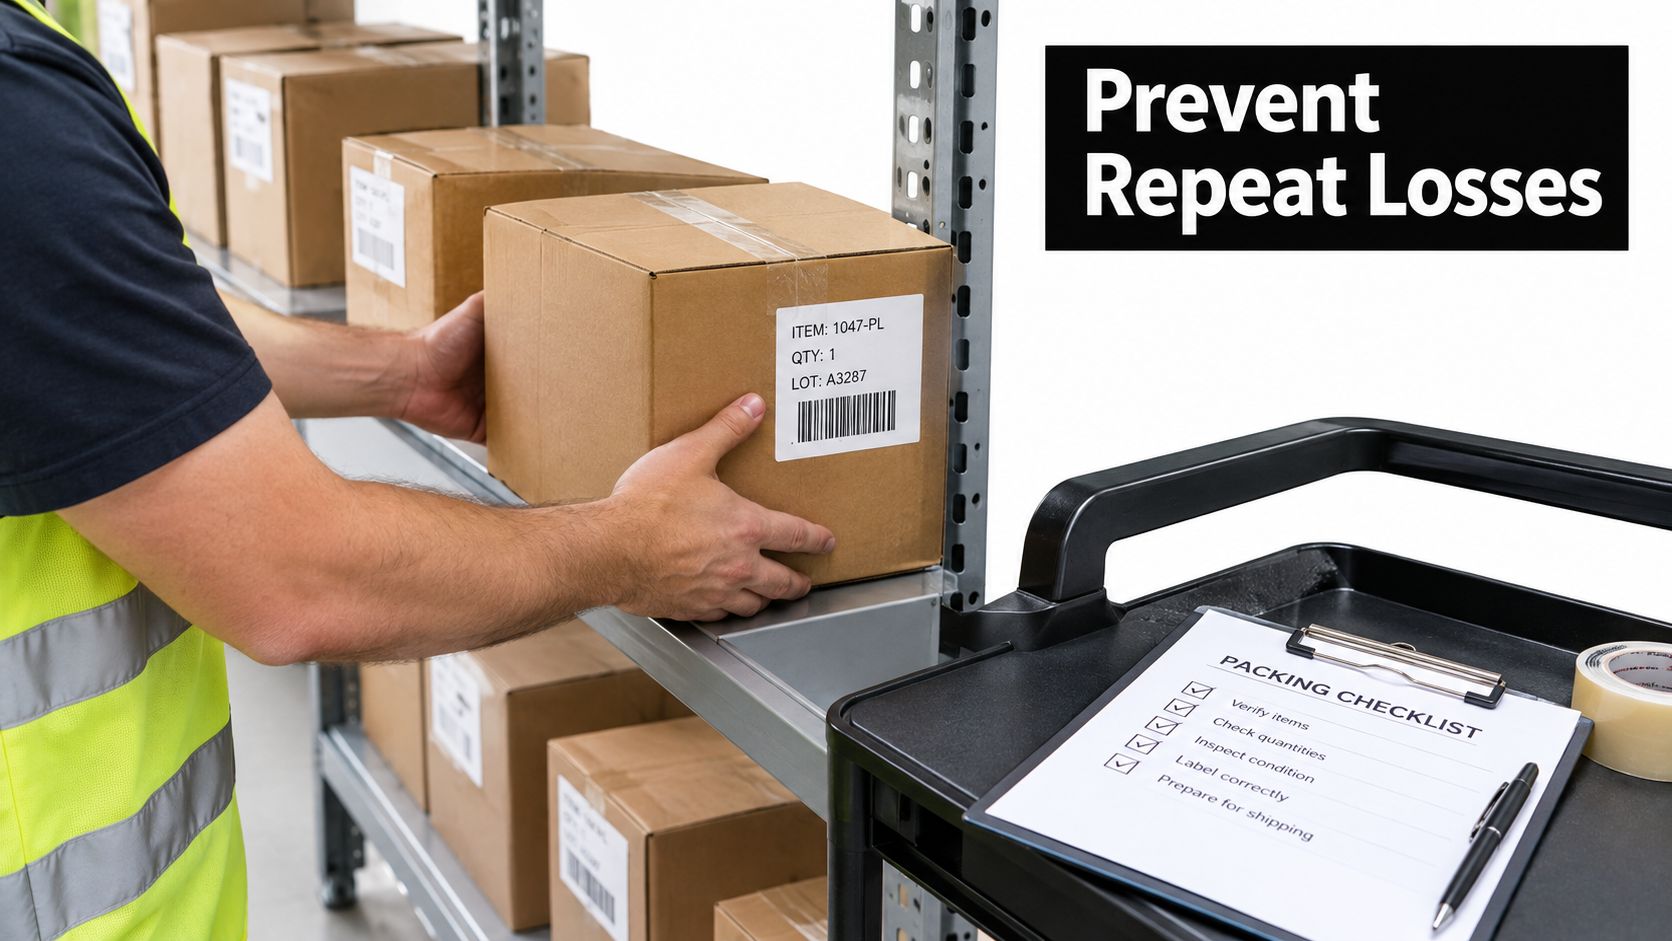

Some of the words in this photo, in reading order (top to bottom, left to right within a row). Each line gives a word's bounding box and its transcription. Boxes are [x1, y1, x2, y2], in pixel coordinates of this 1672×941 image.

[792, 323, 828, 339] ITEM:
[833, 317, 885, 335] 1047-PL
[791, 349, 824, 365] QTY:
[829, 348, 835, 361] 1
[791, 375, 822, 391] LOT:
[826, 369, 867, 387] A3287
[1219, 654, 1332, 697] PACKING
[1336, 690, 1484, 740] CHECKLIST
[1231, 698, 1270, 718] Verify
[1271, 711, 1311, 731] items
[1194, 735, 1247, 761] Inspect
[1248, 754, 1316, 784] condition
[1212, 716, 1256, 738] Check
[1258, 730, 1328, 762] quantities
[1174, 753, 1217, 778] Label
[1219, 770, 1291, 804] correctly
[1156, 773, 1218, 804] Prepare
[1221, 797, 1246, 816] for
[1245, 806, 1315, 843] shipping
